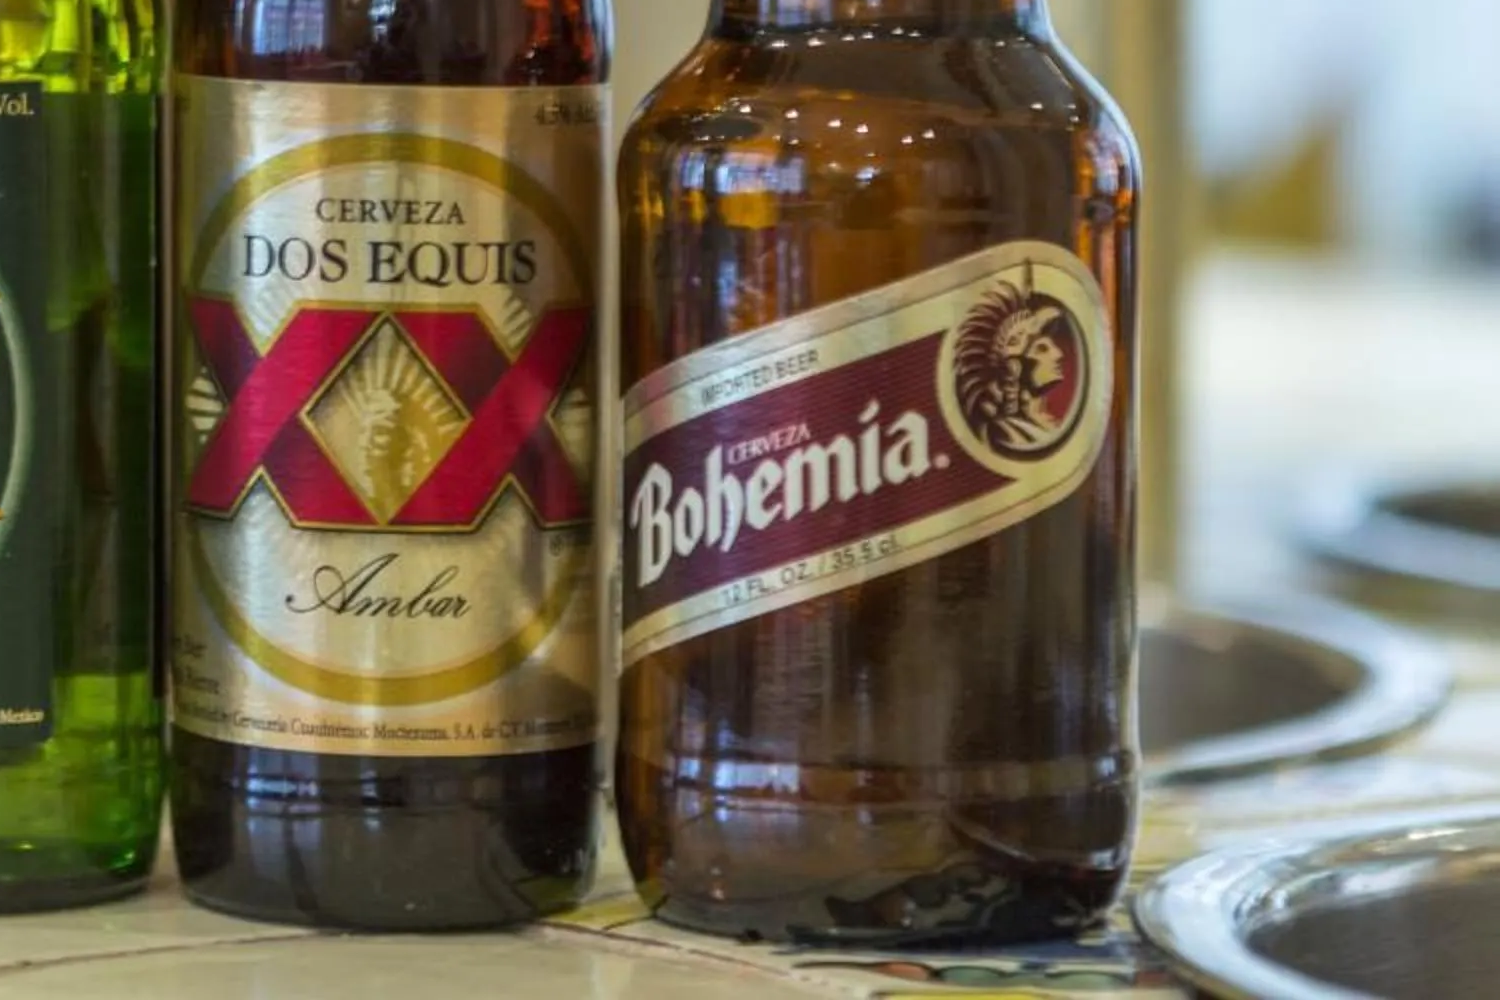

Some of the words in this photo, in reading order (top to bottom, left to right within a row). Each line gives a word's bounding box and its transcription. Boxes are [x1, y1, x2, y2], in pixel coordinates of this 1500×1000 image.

[314, 197, 466, 226] CERVEZA
[242, 235, 349, 284] DOS
[366, 239, 538, 286] EQUIS
[701, 367, 773, 407] IMPORTED
[774, 348, 820, 380] BEER
[726, 423, 811, 465] CERVEZA
[284, 552, 473, 620] Ambar
